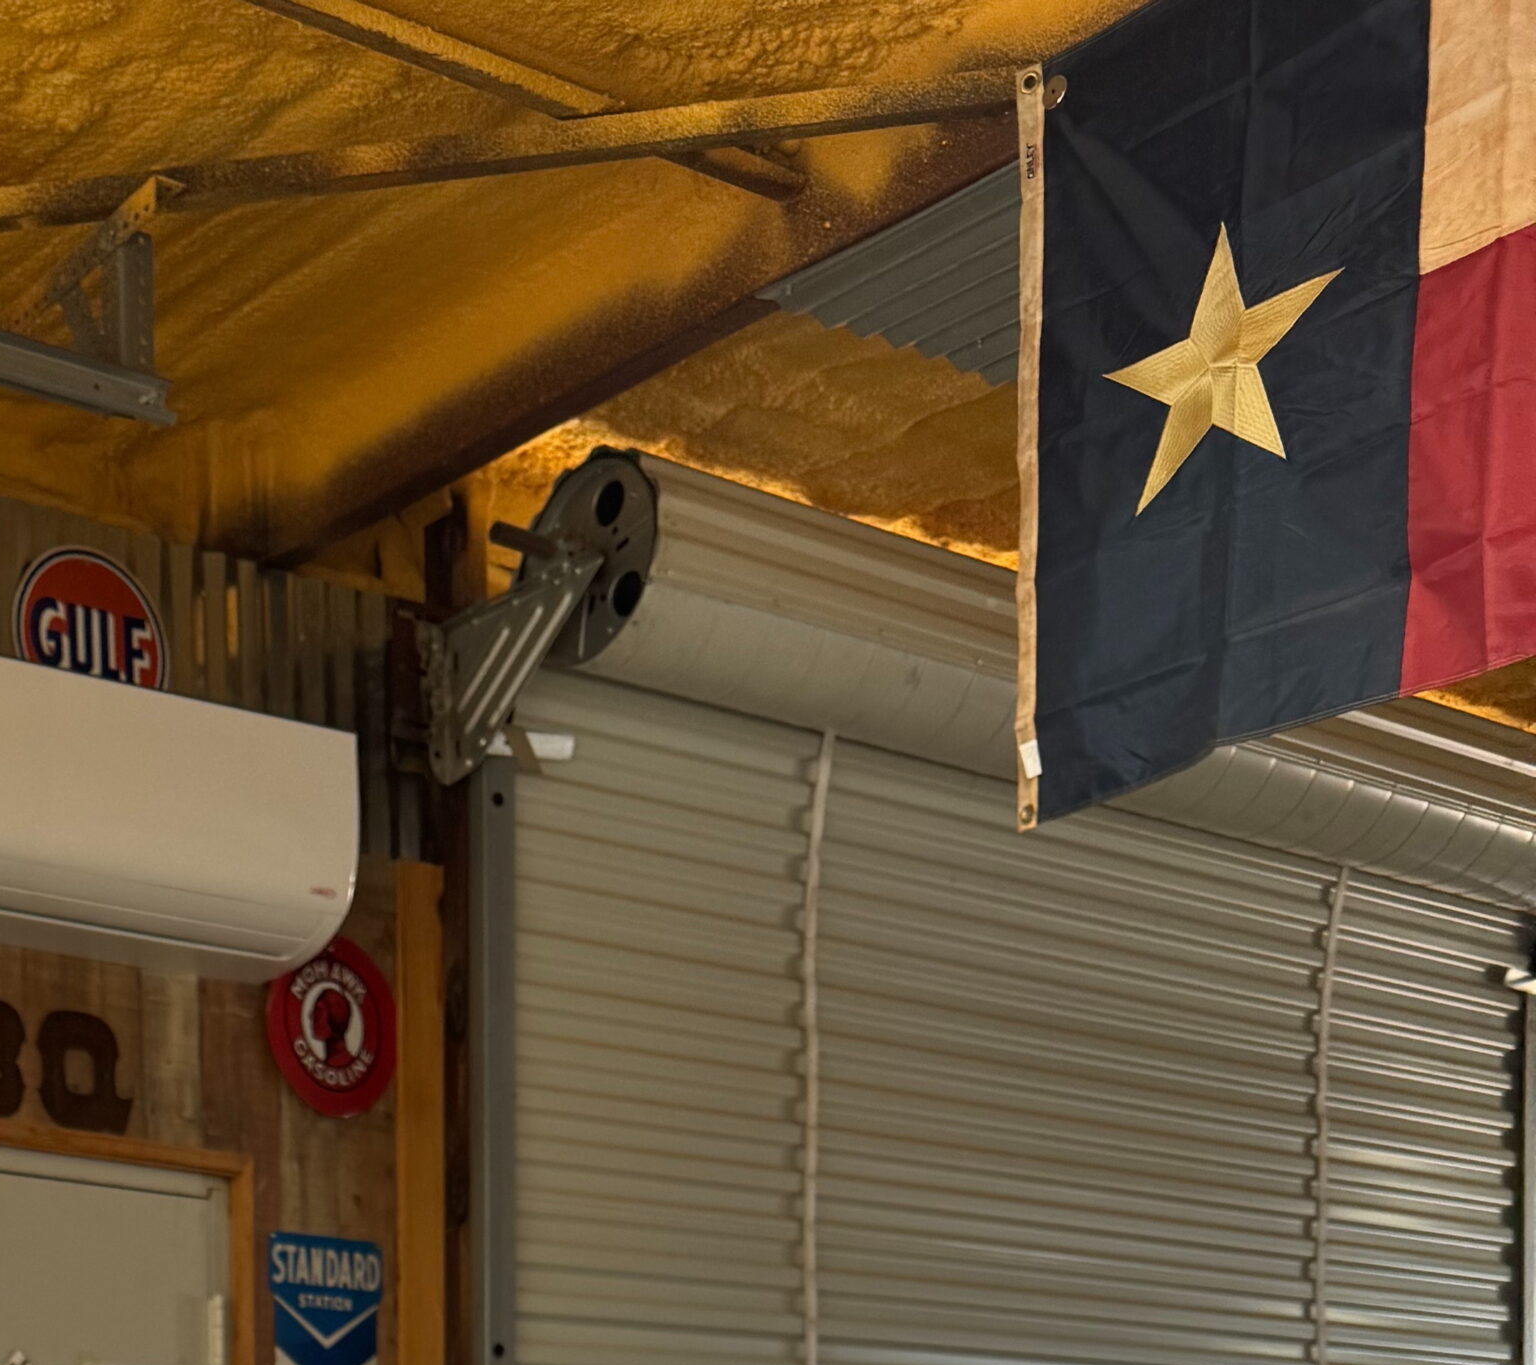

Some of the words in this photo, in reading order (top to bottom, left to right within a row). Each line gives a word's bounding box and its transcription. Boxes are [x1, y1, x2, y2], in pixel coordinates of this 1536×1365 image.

[30, 596, 154, 685] GULF
[293, 1036, 374, 1087] GASOLINE
[271, 1243, 381, 1292] STANDARD
[297, 1291, 354, 1312] STATION
